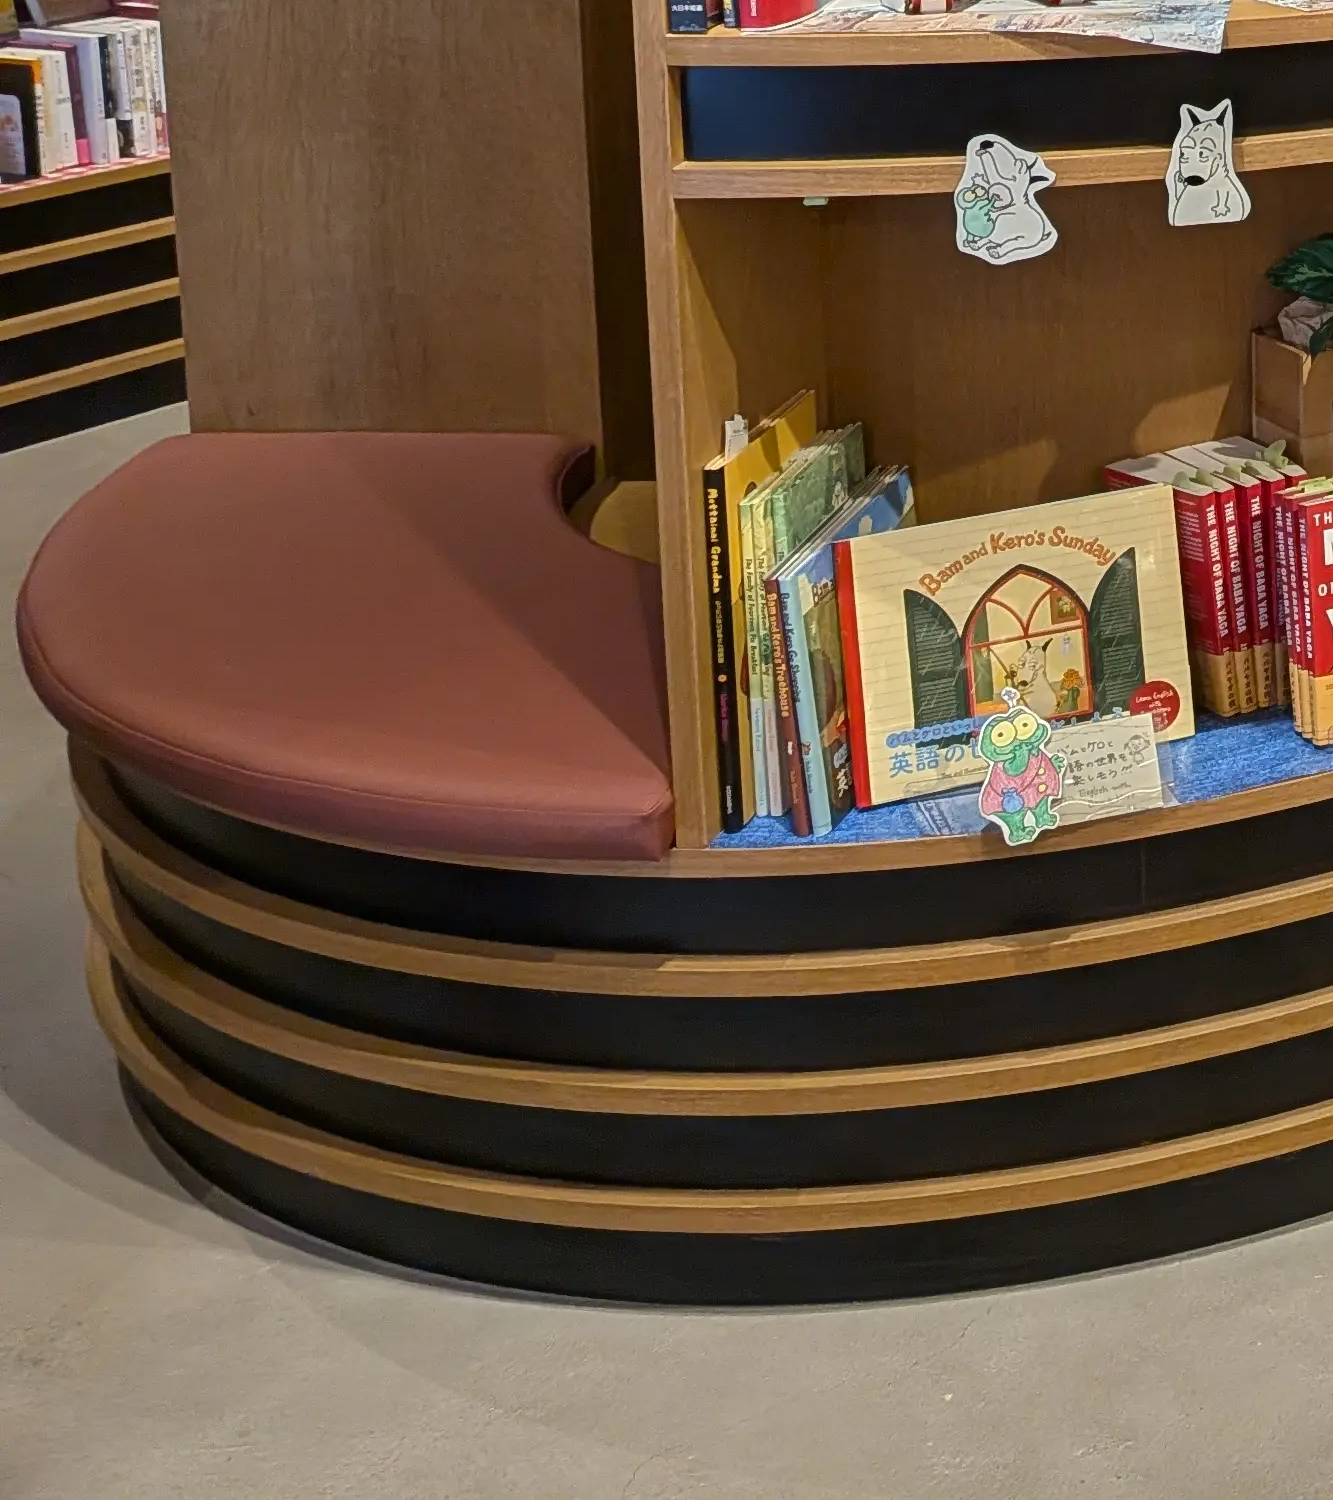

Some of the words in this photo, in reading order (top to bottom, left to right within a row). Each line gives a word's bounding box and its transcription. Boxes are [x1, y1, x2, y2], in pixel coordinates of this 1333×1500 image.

[918, 560, 963, 597] Bam
[962, 542, 989, 566] and
[989, 529, 1046, 555] Kero's
[1047, 526, 1118, 567] Sunday
